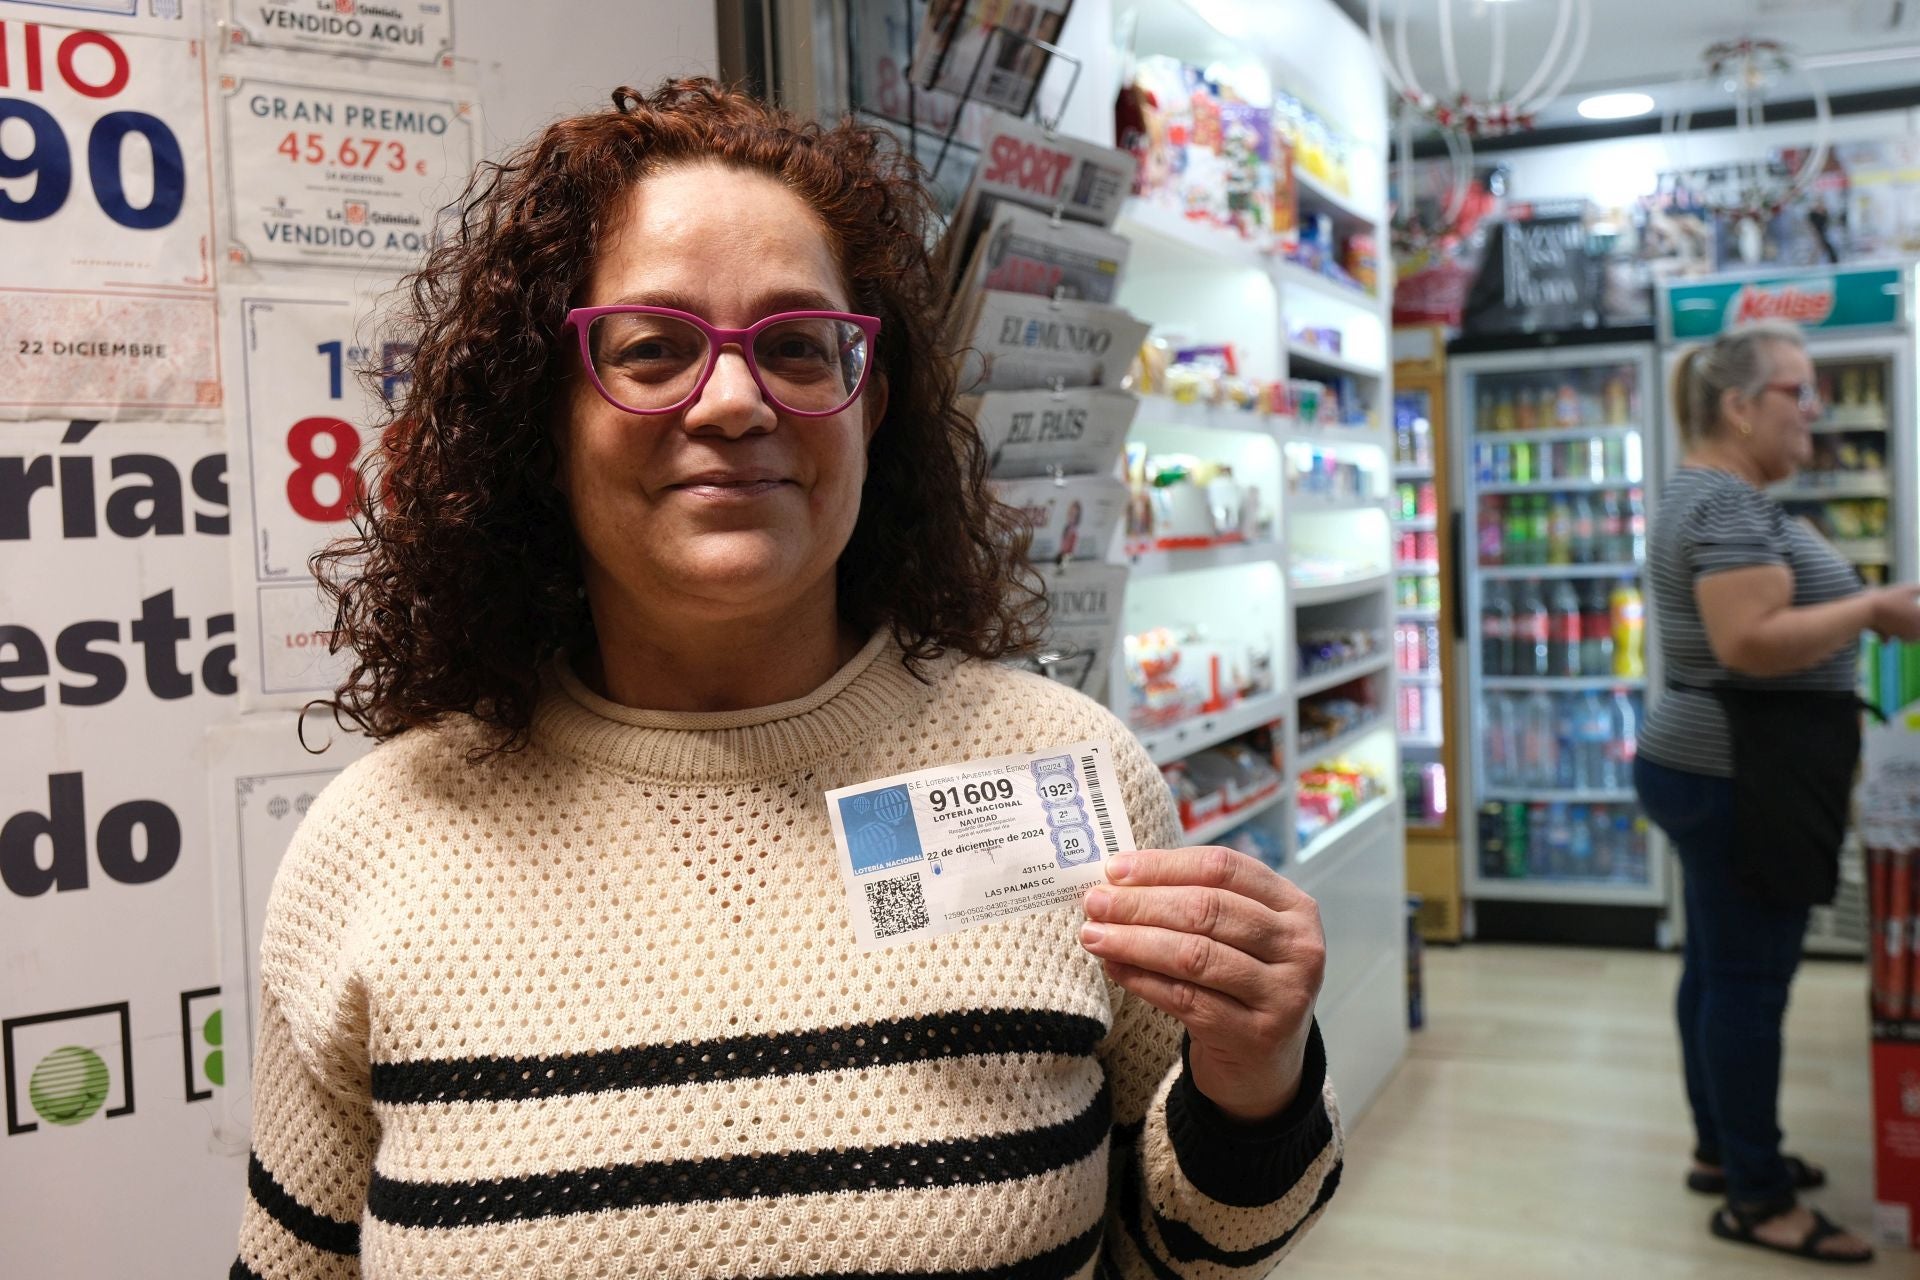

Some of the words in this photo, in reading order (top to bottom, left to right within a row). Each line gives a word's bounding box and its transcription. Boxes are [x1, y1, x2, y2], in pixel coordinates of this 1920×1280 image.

[260, 8, 362, 37] VENDIDO
[371, 24, 424, 45] AQUÍ
[0, 20, 130, 98] IO
[250, 95, 333, 124] GRAN
[345, 105, 447, 136] PREMIO
[0, 98, 186, 231] 90
[278, 131, 407, 172] 45.673
[415, 160, 428, 176] €
[985, 133, 1073, 198] SPORT
[263, 223, 375, 248] VENDIDO
[999, 315, 1024, 345] EL
[19, 340, 43, 355] 22
[53, 341, 167, 358] DICIEMBRE
[1007, 411, 1034, 444] EL
[1038, 407, 1088, 442] PAÍS
[0, 420, 230, 540] rías
[1039, 763, 1062, 772] 102/24
[908, 780, 924, 791] S.E.
[929, 779, 1014, 812] 91609
[933, 808, 973, 823] LOTERÍA
[976, 800, 1023, 814] NACIONAL
[960, 814, 998, 827] NAVIDAD
[0, 771, 181, 897] do
[927, 852, 939, 861] 22
[941, 847, 954, 857] de
[956, 837, 1004, 853] diciembre
[1007, 833, 1019, 842] de
[1021, 828, 1044, 840] 2024
[1064, 838, 1079, 849] 20
[854, 862, 885, 876] LOTERÍA
[885, 855, 924, 869] NACIONAL
[1063, 848, 1085, 857] EUROS
[1022, 862, 1055, 874] 43115-0
[985, 889, 1002, 898] LAS
[1004, 880, 1040, 894] PALMAS
[1041, 876, 1055, 885] GC
